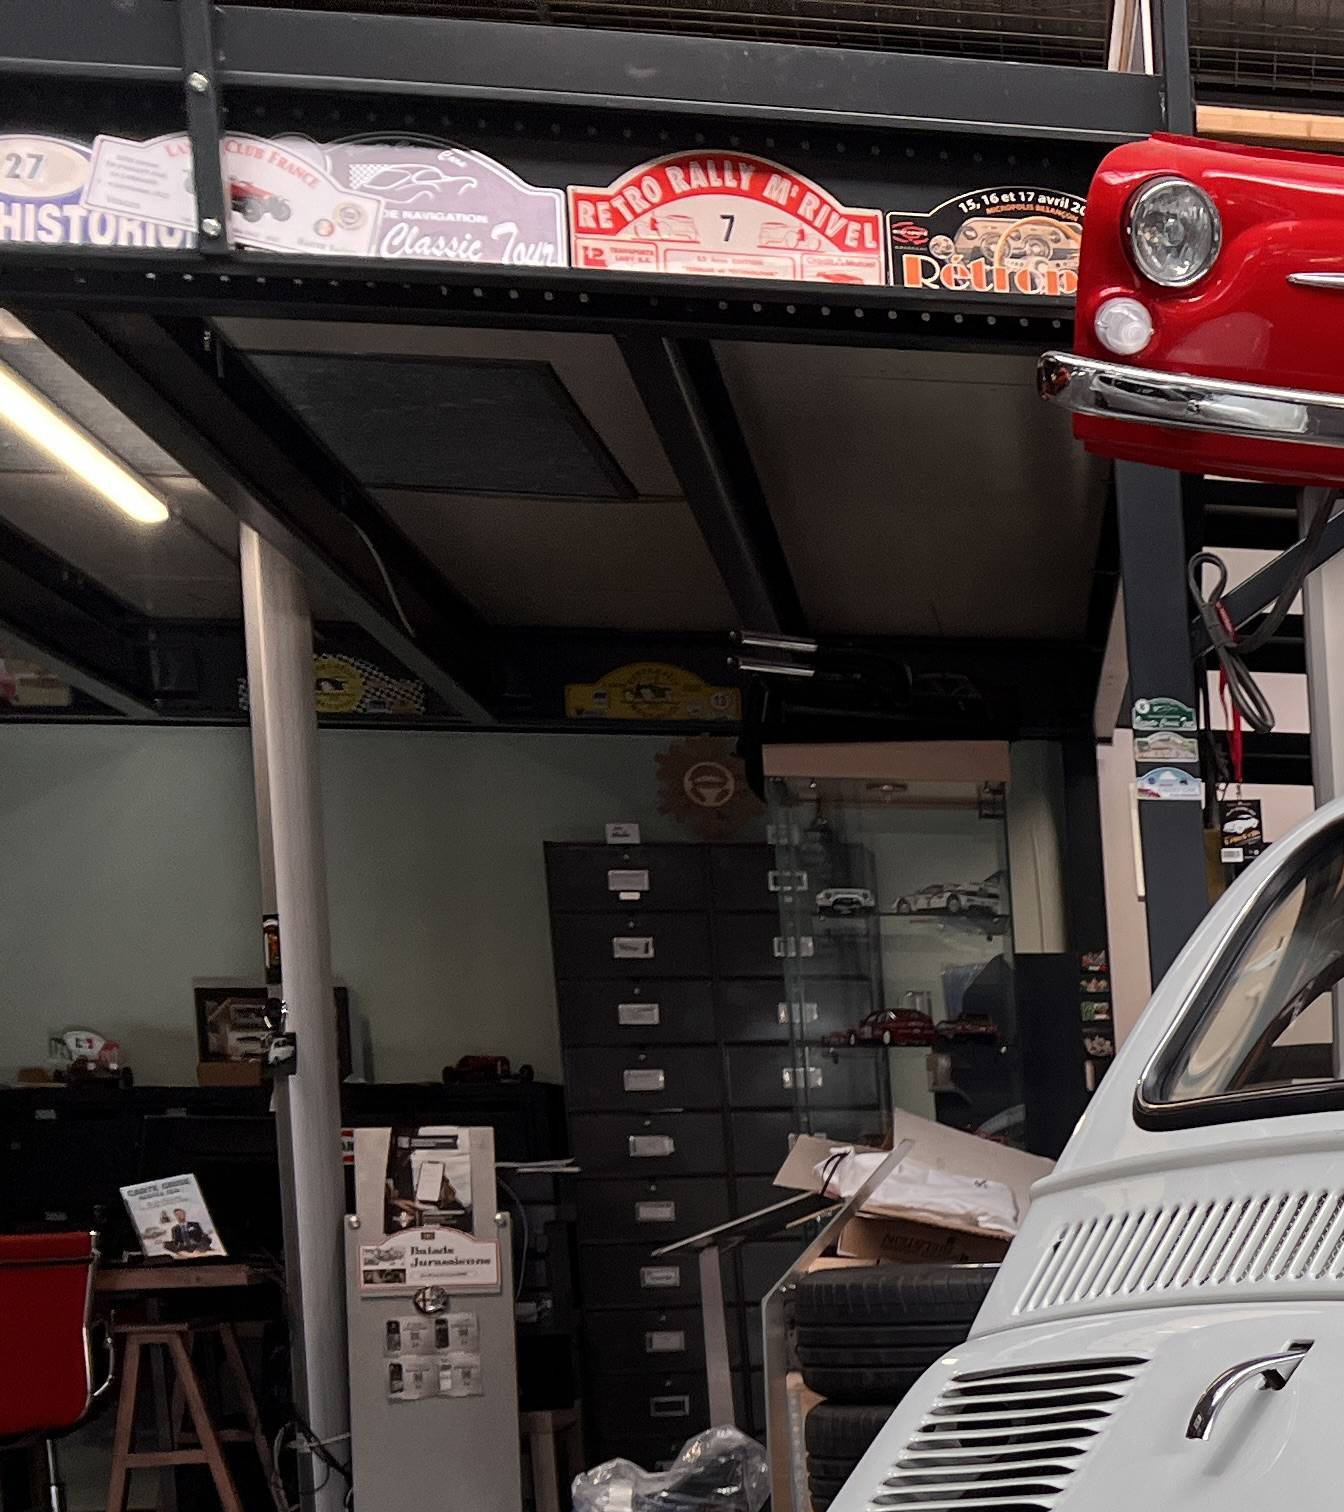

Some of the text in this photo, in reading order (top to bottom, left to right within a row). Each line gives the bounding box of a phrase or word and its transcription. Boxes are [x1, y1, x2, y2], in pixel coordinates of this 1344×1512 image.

[5, 153, 44, 180] 27
[266, 151, 320, 189] FRANCE
[577, 176, 663, 230] RETRO
[665, 160, 755, 194] RALLY
[797, 191, 878, 249] RIVEL
[958, 198, 980, 213] 15,
[981, 193, 999, 205] 16
[1001, 191, 1016, 202] et
[1018, 191, 1035, 202] 17
[1038, 194, 1069, 209] avril
[402, 210, 489, 224] NAVIGATION
[720, 214, 734, 242] 7
[380, 222, 483, 261] Classic
[491, 222, 555, 265] Tour
